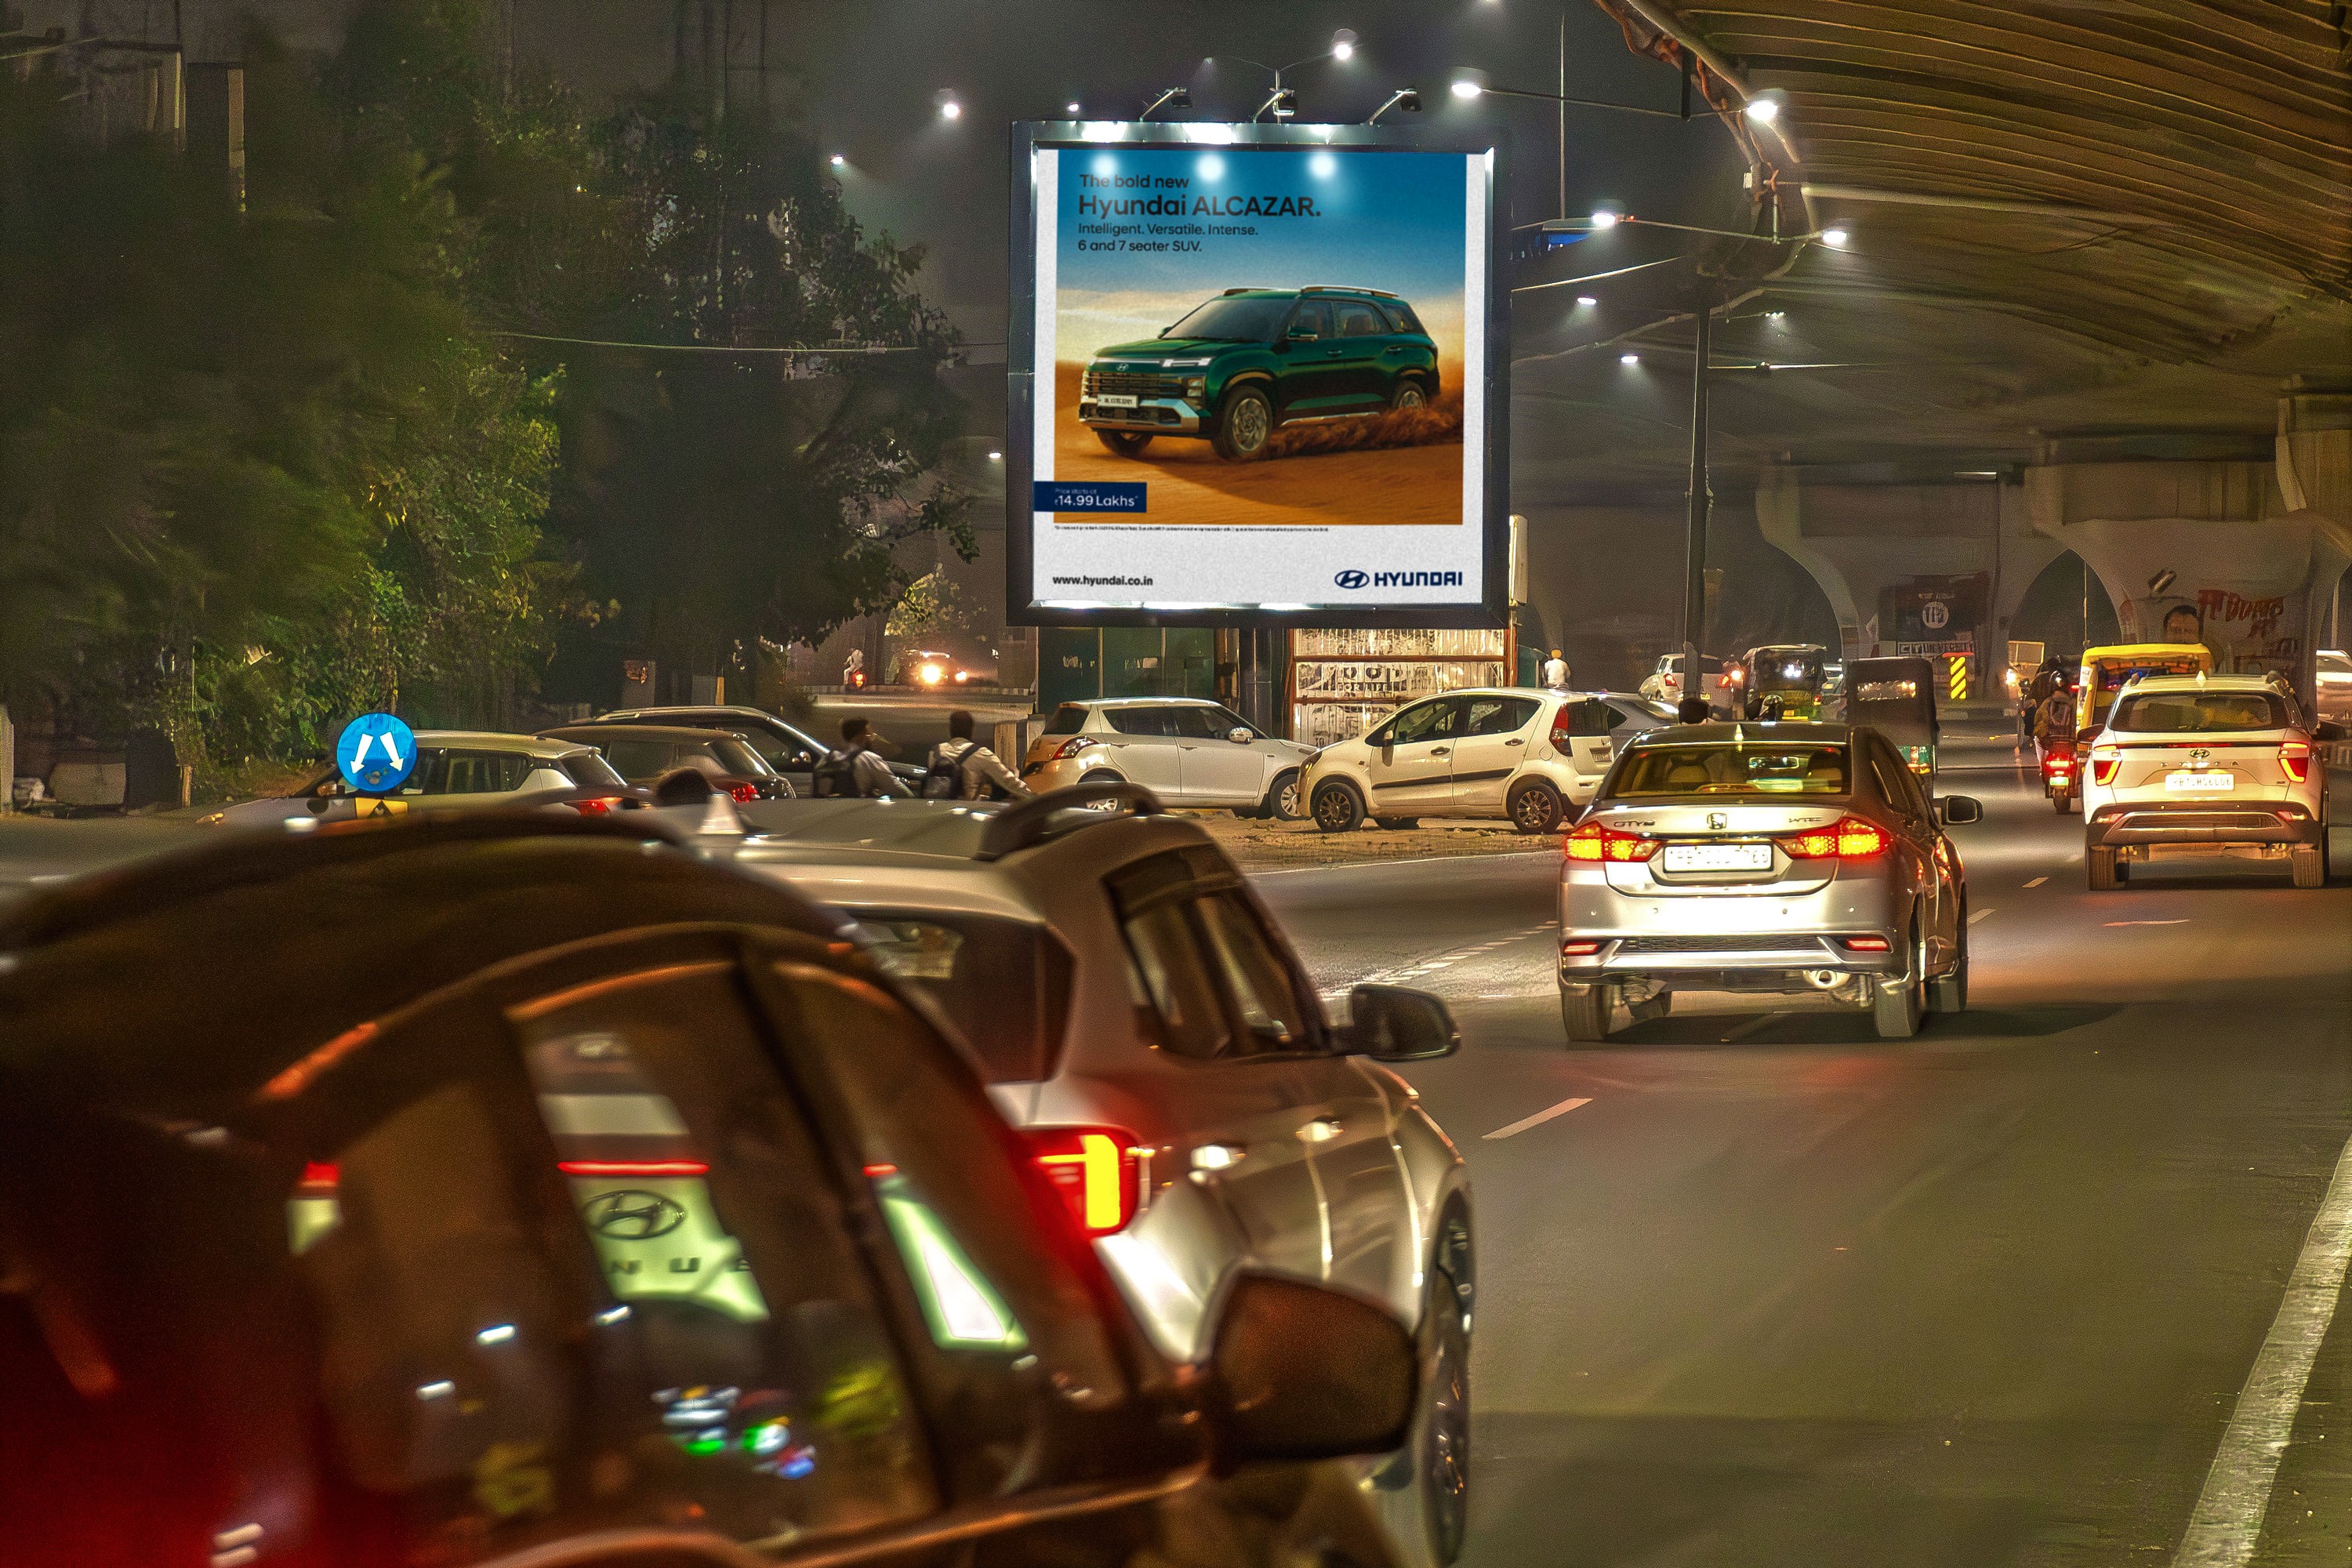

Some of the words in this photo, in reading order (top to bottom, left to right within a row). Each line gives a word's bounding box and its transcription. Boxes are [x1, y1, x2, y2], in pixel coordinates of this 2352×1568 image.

[1079, 174, 1110, 188] The
[1114, 174, 1151, 188] bold
[1155, 177, 1189, 188] new
[1078, 194, 1186, 220] Hyundai
[1191, 195, 1321, 217] ALCAZAR.
[1078, 223, 1145, 237] Intelligent.
[1146, 223, 1205, 235] Versatile.
[1208, 223, 1258, 235] Intense.
[1077, 240, 1087, 251] 6
[1090, 239, 1116, 251] and
[1118, 240, 1127, 251] 7
[1129, 240, 1169, 252] seater
[1172, 240, 1203, 252] SUV.
[1052, 575, 1153, 586] www.hyundai.co.in
[1374, 572, 1463, 586] HYUNDAI
